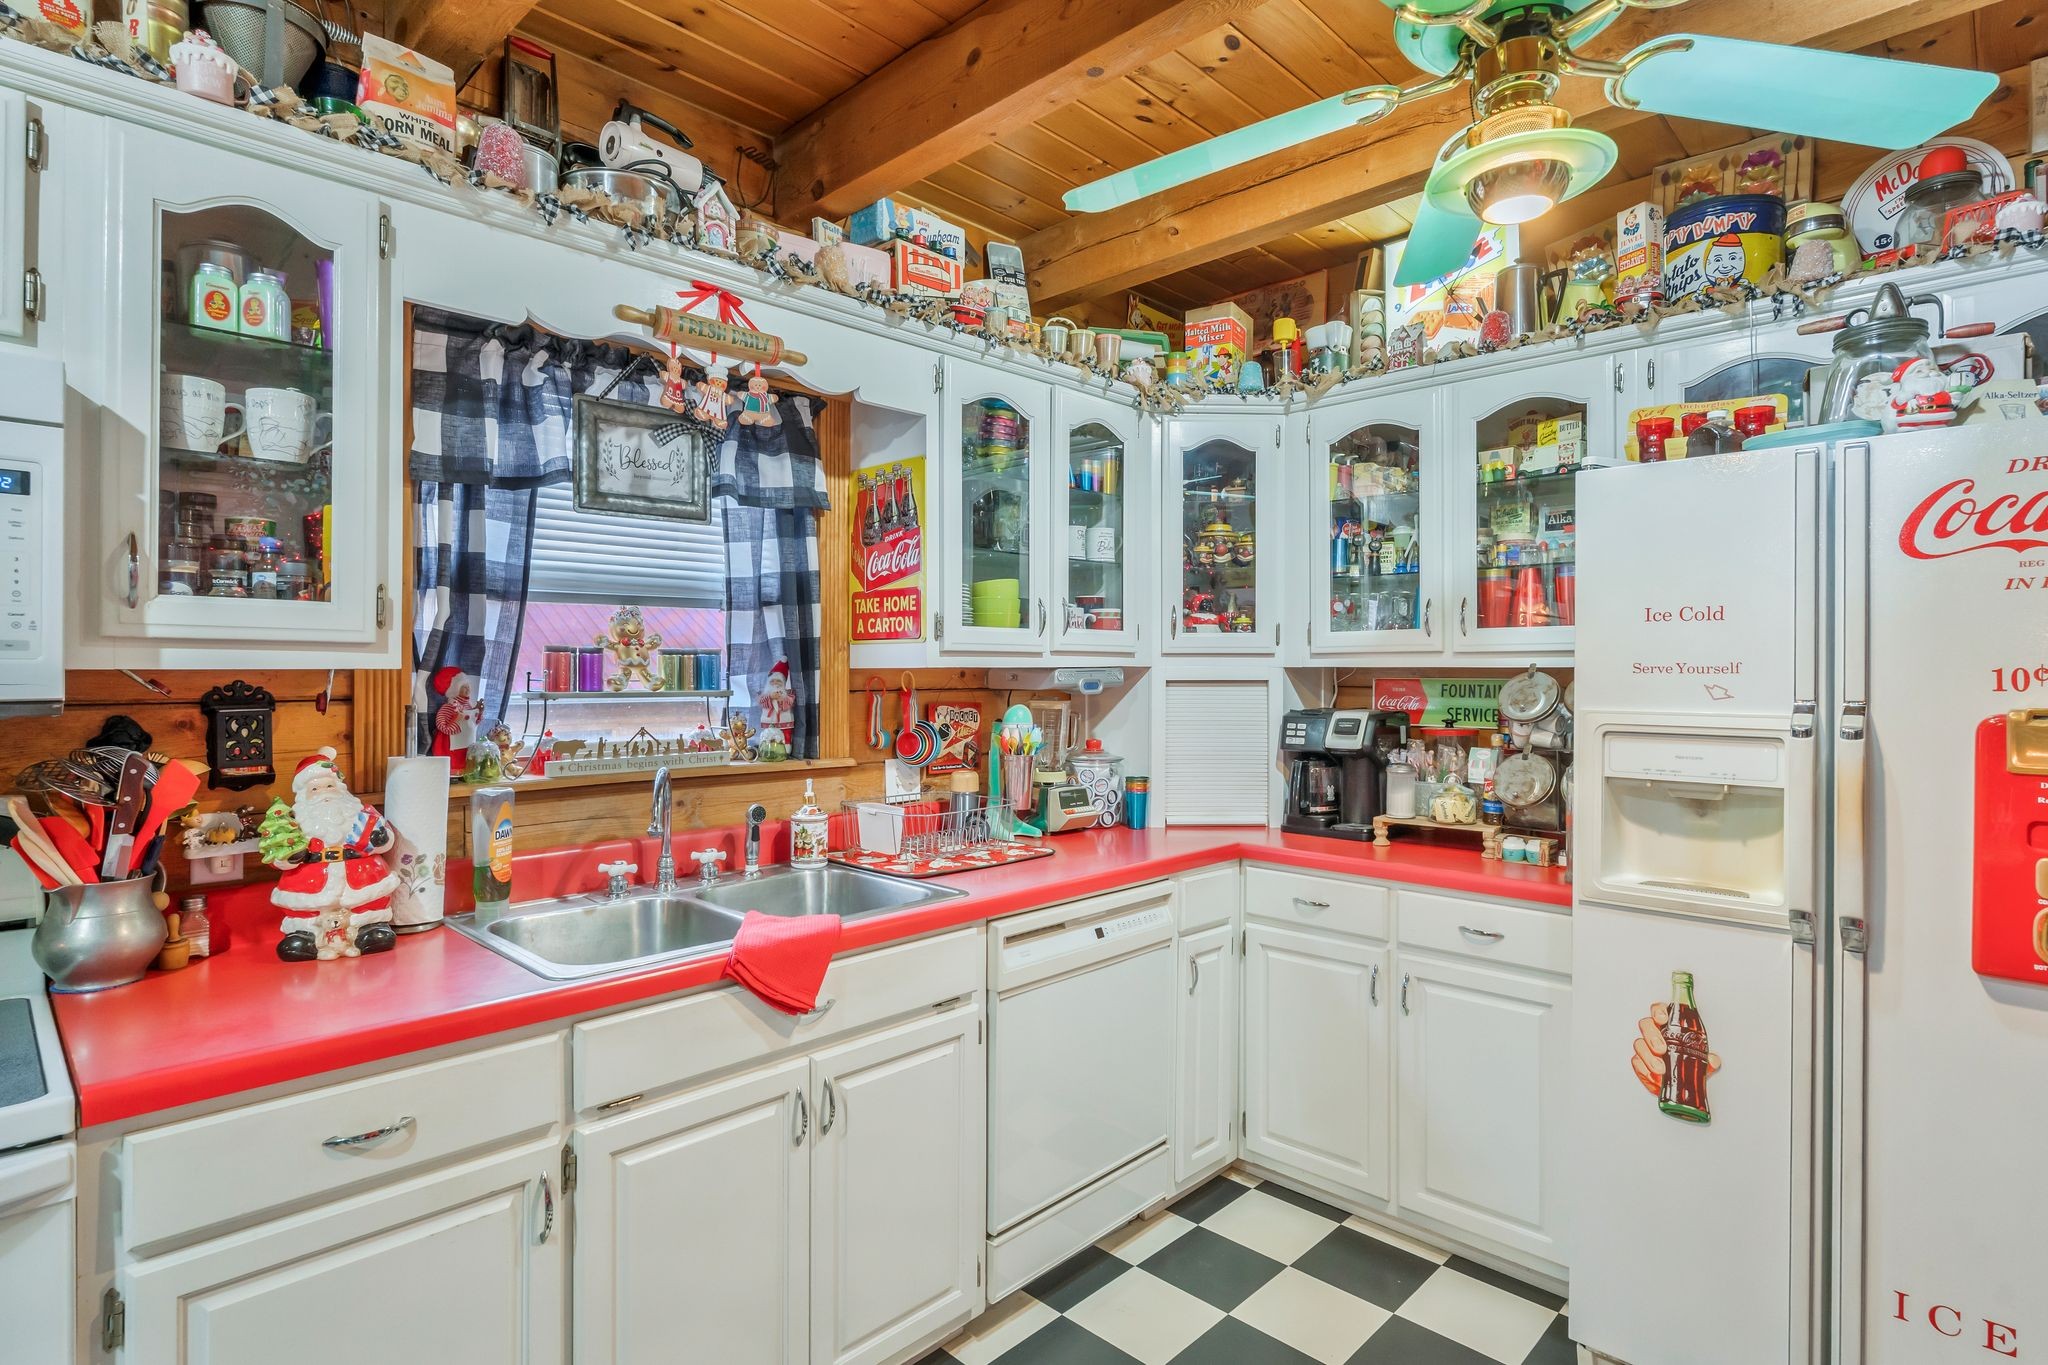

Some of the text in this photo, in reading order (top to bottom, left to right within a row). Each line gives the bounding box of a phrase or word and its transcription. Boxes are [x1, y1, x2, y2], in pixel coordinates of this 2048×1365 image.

[398, 111, 435, 130] WHITE
[420, 127, 453, 153] MEAL
[916, 219, 930, 229] LARGE
[1692, 211, 1758, 241] DUMPTY
[678, 315, 770, 352] FRESH DAILY
[1185, 327, 1210, 337] Malted
[1210, 322, 1232, 333] Milk
[1198, 333, 1225, 343] Mixer
[1984, 391, 2039, 400] Alka-Seltzer
[614, 443, 676, 473] Blessed
[885, 529, 904, 543] DRINK
[866, 534, 921, 582] Coca-Cola
[2004, 577, 2036, 590] IN
[854, 594, 917, 615] TAKE HOME
[1644, 605, 1725, 622] Ice Cold
[856, 615, 914, 634] A CARTON
[1632, 661, 1742, 675] Serve Yourself
[1377, 694, 1421, 711] Coca-Cola
[1446, 707, 1498, 723] SERVICE
[568, 755, 717, 773] Christmas begins with Christ
[1893, 1289, 2018, 1358] ICE
